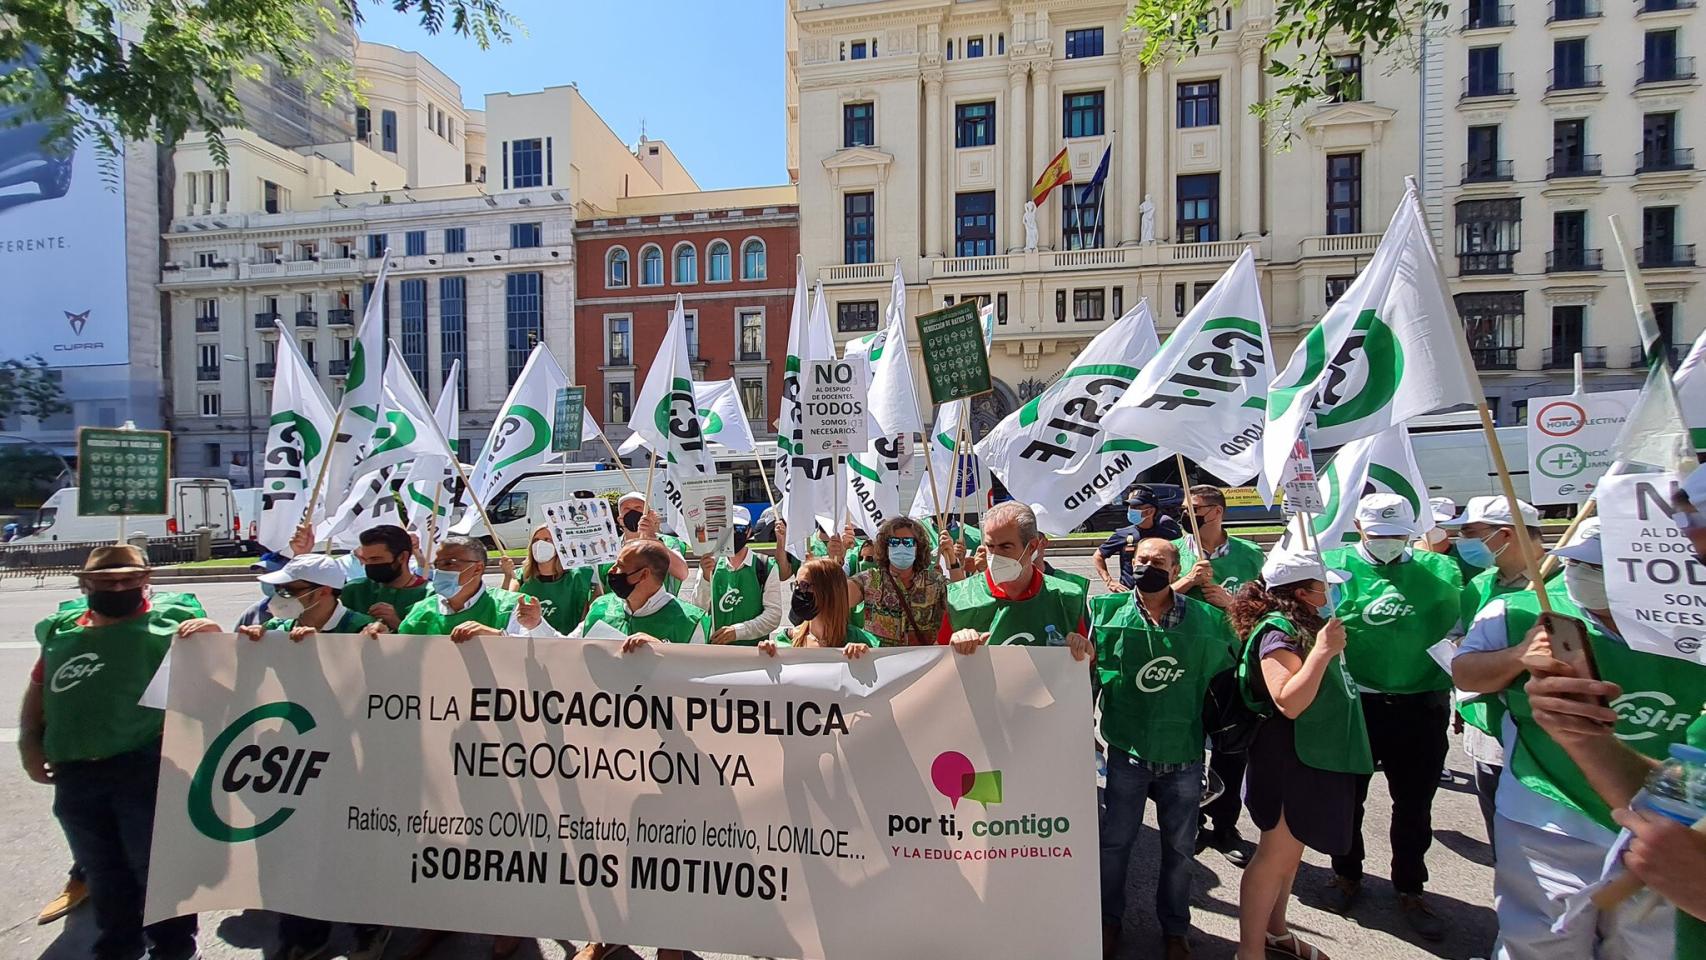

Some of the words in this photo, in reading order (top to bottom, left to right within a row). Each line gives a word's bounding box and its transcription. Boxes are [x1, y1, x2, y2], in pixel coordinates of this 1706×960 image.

[53, 342, 104, 351] CUPRA
[815, 363, 853, 384] NO
[806, 402, 862, 415] TODOS
[1585, 416, 1627, 425] LECTIVA
[851, 476, 886, 527] MADRI
[1640, 528, 1661, 538] AL
[1632, 542, 1652, 552] DE
[367, 694, 421, 721] POR
[429, 695, 461, 722] LA
[470, 684, 674, 731] EDUCACIÓN
[686, 688, 849, 736] PÚBLICA
[221, 744, 331, 796] CSIF
[453, 741, 701, 787] NEGOCIACIÓN
[708, 753, 756, 787] YA
[347, 806, 401, 836] Ratios,
[406, 809, 484, 837] refuerzos
[488, 811, 551, 844] COVID,
[557, 814, 630, 848] Estatuto,
[636, 816, 698, 847] horario
[701, 820, 761, 854] lectivo,
[766, 824, 867, 861] LOMLOE...
[887, 813, 933, 838] por
[938, 814, 964, 840] ti,
[971, 813, 1071, 839] contigo
[891, 846, 900, 858] Y
[903, 846, 922, 859] LA
[924, 845, 1008, 860] EDUCACIÓN
[1010, 844, 1073, 859] PÚBLICA
[410, 846, 549, 884] ¡SOBRAN
[559, 851, 620, 889] LOS
[630, 856, 790, 902] MOTIVOS!
